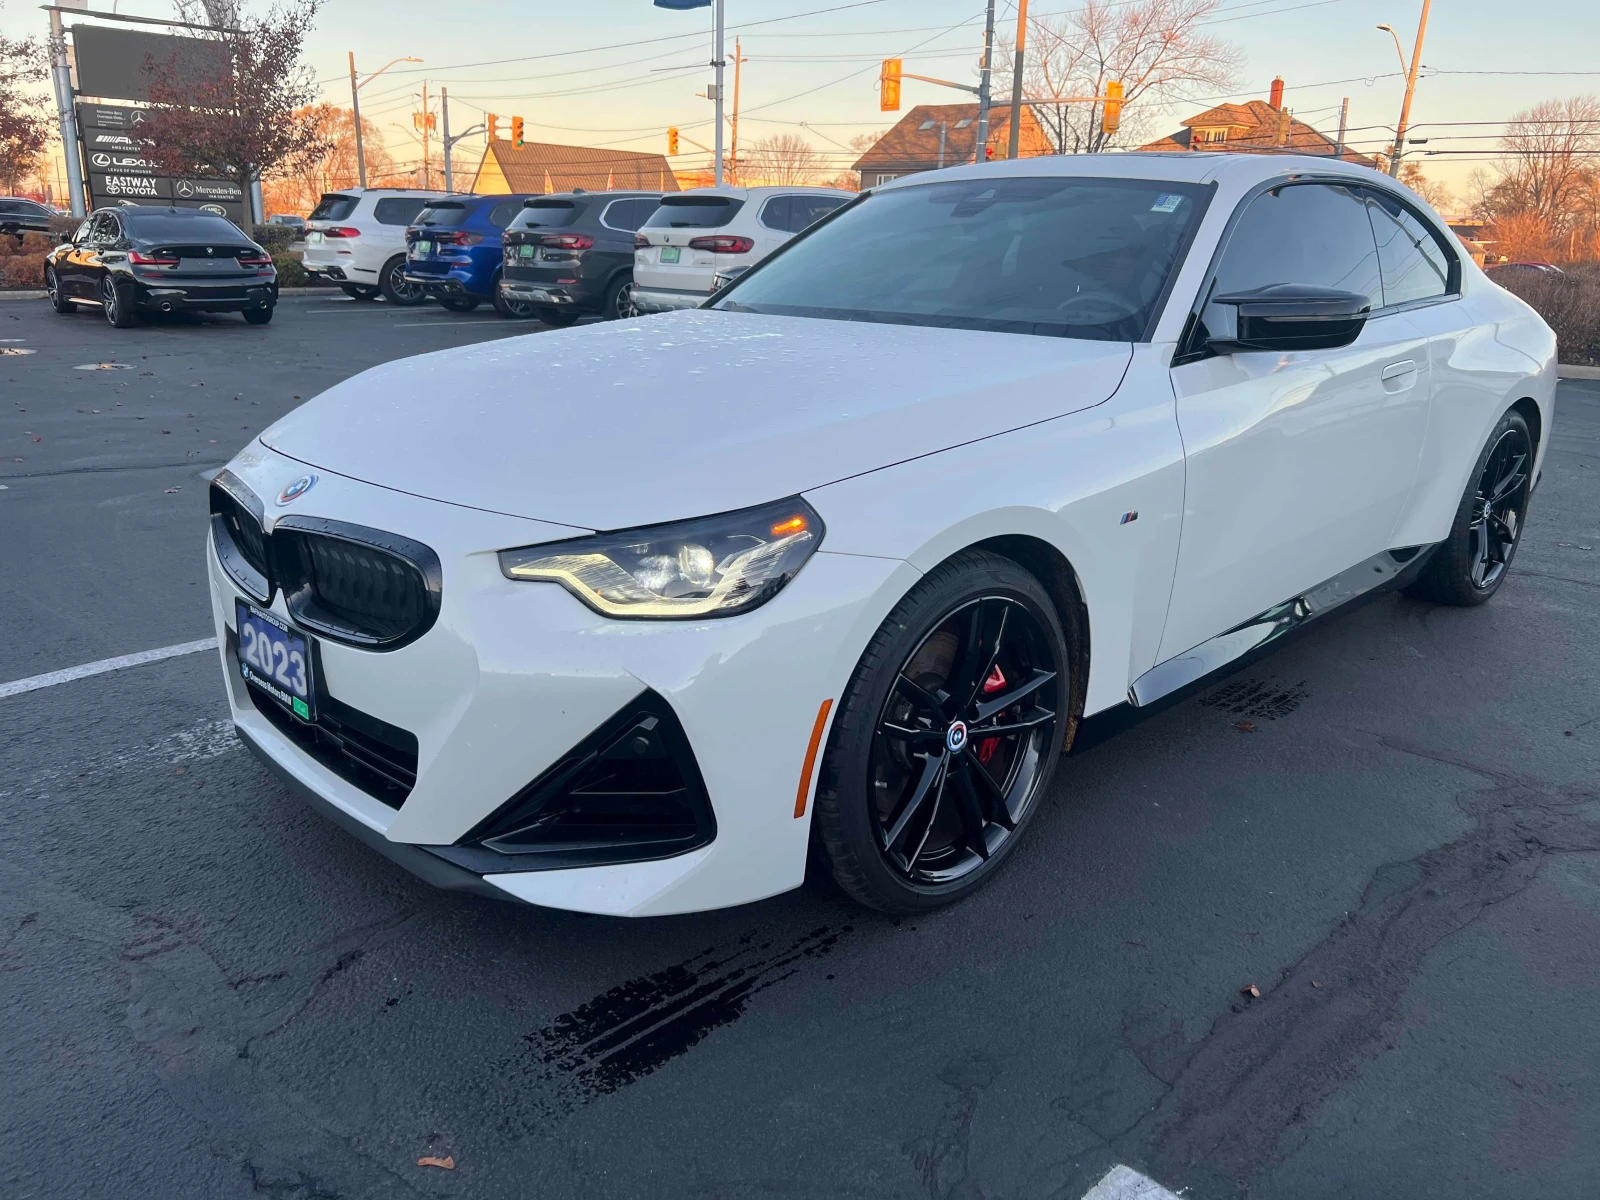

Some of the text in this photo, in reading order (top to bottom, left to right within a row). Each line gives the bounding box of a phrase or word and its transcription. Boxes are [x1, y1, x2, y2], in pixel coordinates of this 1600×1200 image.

[105, 175, 157, 188] EASTWAY
[120, 186, 158, 196] TOYOTA
[195, 186, 242, 196] Mercedes-Ben
[243, 622, 307, 696] 2023
[249, 670, 267, 689] Overseas
[281, 691, 292, 705] BMW
